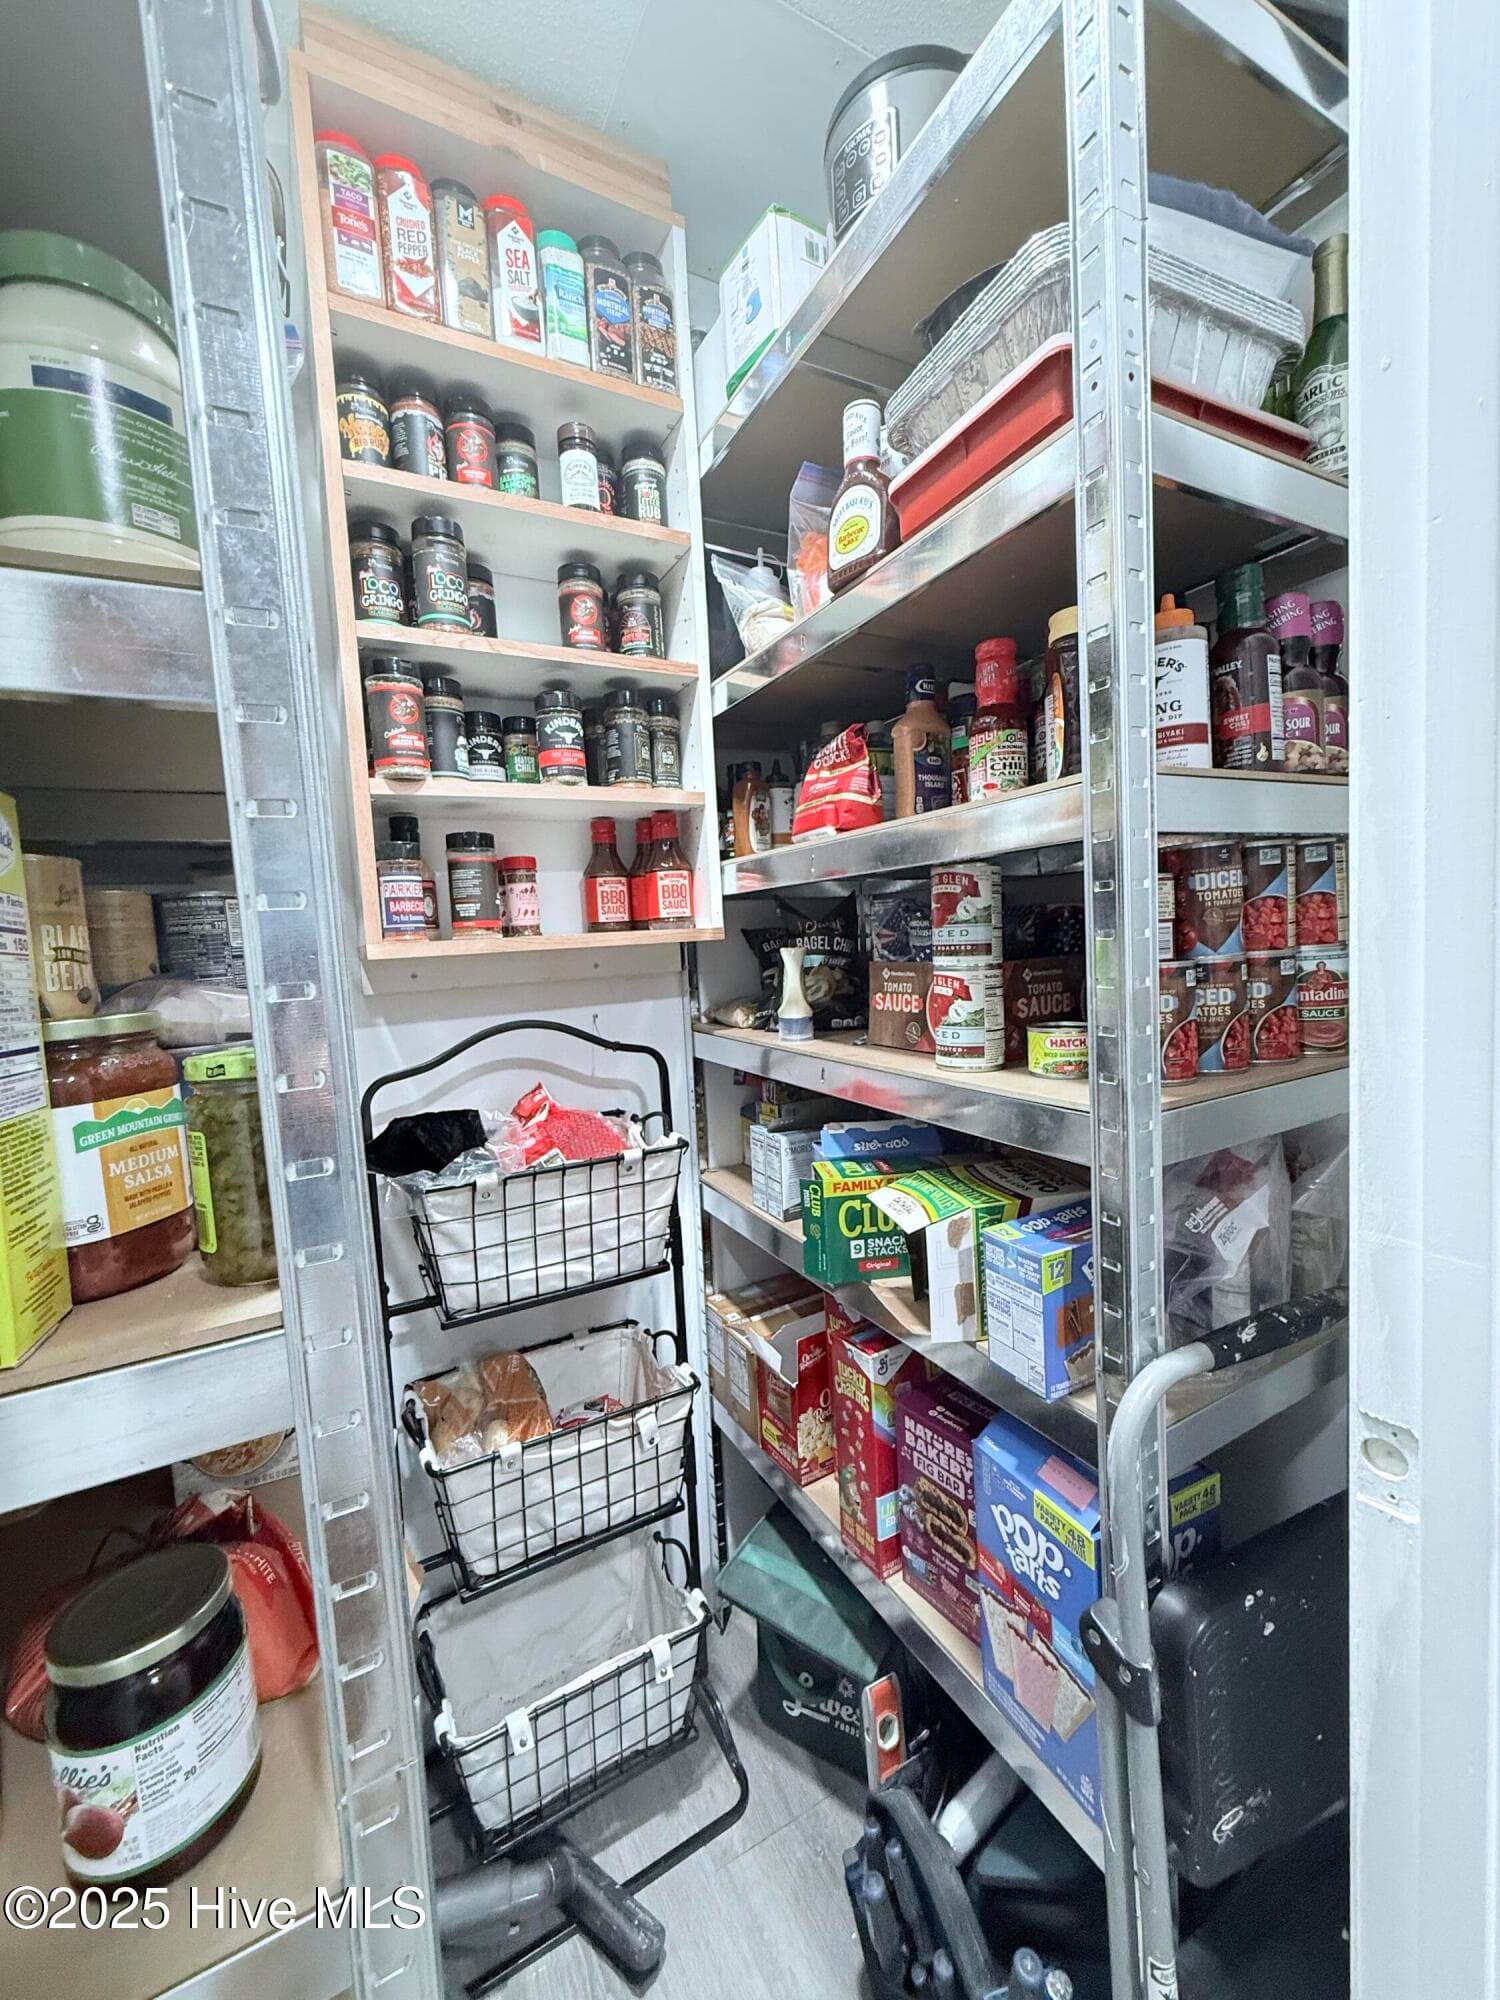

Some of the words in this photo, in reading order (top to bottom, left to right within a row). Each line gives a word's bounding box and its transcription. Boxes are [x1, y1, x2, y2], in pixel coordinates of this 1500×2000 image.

[337, 213, 369, 233] Tone's
[397, 228, 427, 244] RED
[398, 242, 428, 257] PEPPER
[505, 248, 530, 270] SEA
[507, 269, 530, 286] SALT
[597, 296, 630, 316] MONTREAL
[639, 506, 661, 519] RUB
[363, 576, 398, 595] LOCO
[430, 571, 464, 588] LOCO
[361, 595, 403, 610] GRINGO
[429, 591, 469, 606] GRINGO
[1269, 600, 1296, 619] STING
[1269, 607, 1304, 629] MERING
[1223, 713, 1249, 726] SWEET
[1286, 717, 1311, 731] SOUR
[1157, 729, 1184, 738] RIYAKI
[943, 876, 969, 886] GLEN
[1194, 869, 1244, 891] DICED
[600, 890, 626, 905] BBQ
[662, 883, 687, 899] BBQ
[1196, 887, 1244, 902] TOMATOES
[601, 905, 626, 915] SAUCE
[662, 899, 688, 910] SAUCE
[40, 924, 88, 955] BLAC
[796, 936, 831, 950] BAGEL
[884, 981, 912, 993] TOMATO
[940, 979, 960, 989] GLEN
[1028, 981, 1063, 994] TOMATO
[875, 993, 920, 1013] SAUCE
[1017, 992, 1072, 1019] SAUCE
[1302, 1009, 1340, 1018] SAUCE
[1049, 1038, 1087, 1048] HATCH
[79, 1128, 115, 1147] GREEN
[115, 1116, 162, 1135] MOUNTAIN
[163, 1112, 185, 1125] GRING
[109, 1144, 180, 1177] MEDIUM
[124, 1163, 173, 1190] SALSA
[833, 1179, 883, 1194] FAMILY
[809, 1184, 822, 1217] CLUB
[838, 1198, 900, 1239] CLU
[853, 1243, 863, 1255] 9
[867, 1236, 907, 1248] SNACK
[867, 1245, 909, 1257] STACKS
[866, 1260, 891, 1269] Original
[1048, 1259, 1066, 1281] 12
[834, 1374, 870, 1413] Charms
[904, 1416, 973, 1466] NATURE'S
[905, 1430, 973, 1484] BAKERY
[917, 1455, 935, 1476] FIG
[937, 1466, 961, 1493] BAR
[1034, 1500, 1067, 1530] VARIETY
[1041, 1512, 1061, 1535] PACK
[1068, 1524, 1086, 1548] 48
[134, 1723, 181, 1754] Nutrition
[135, 1744, 165, 1763] Facts
[141, 1779, 177, 1801] Calories
[183, 1765, 197, 1782] 20
